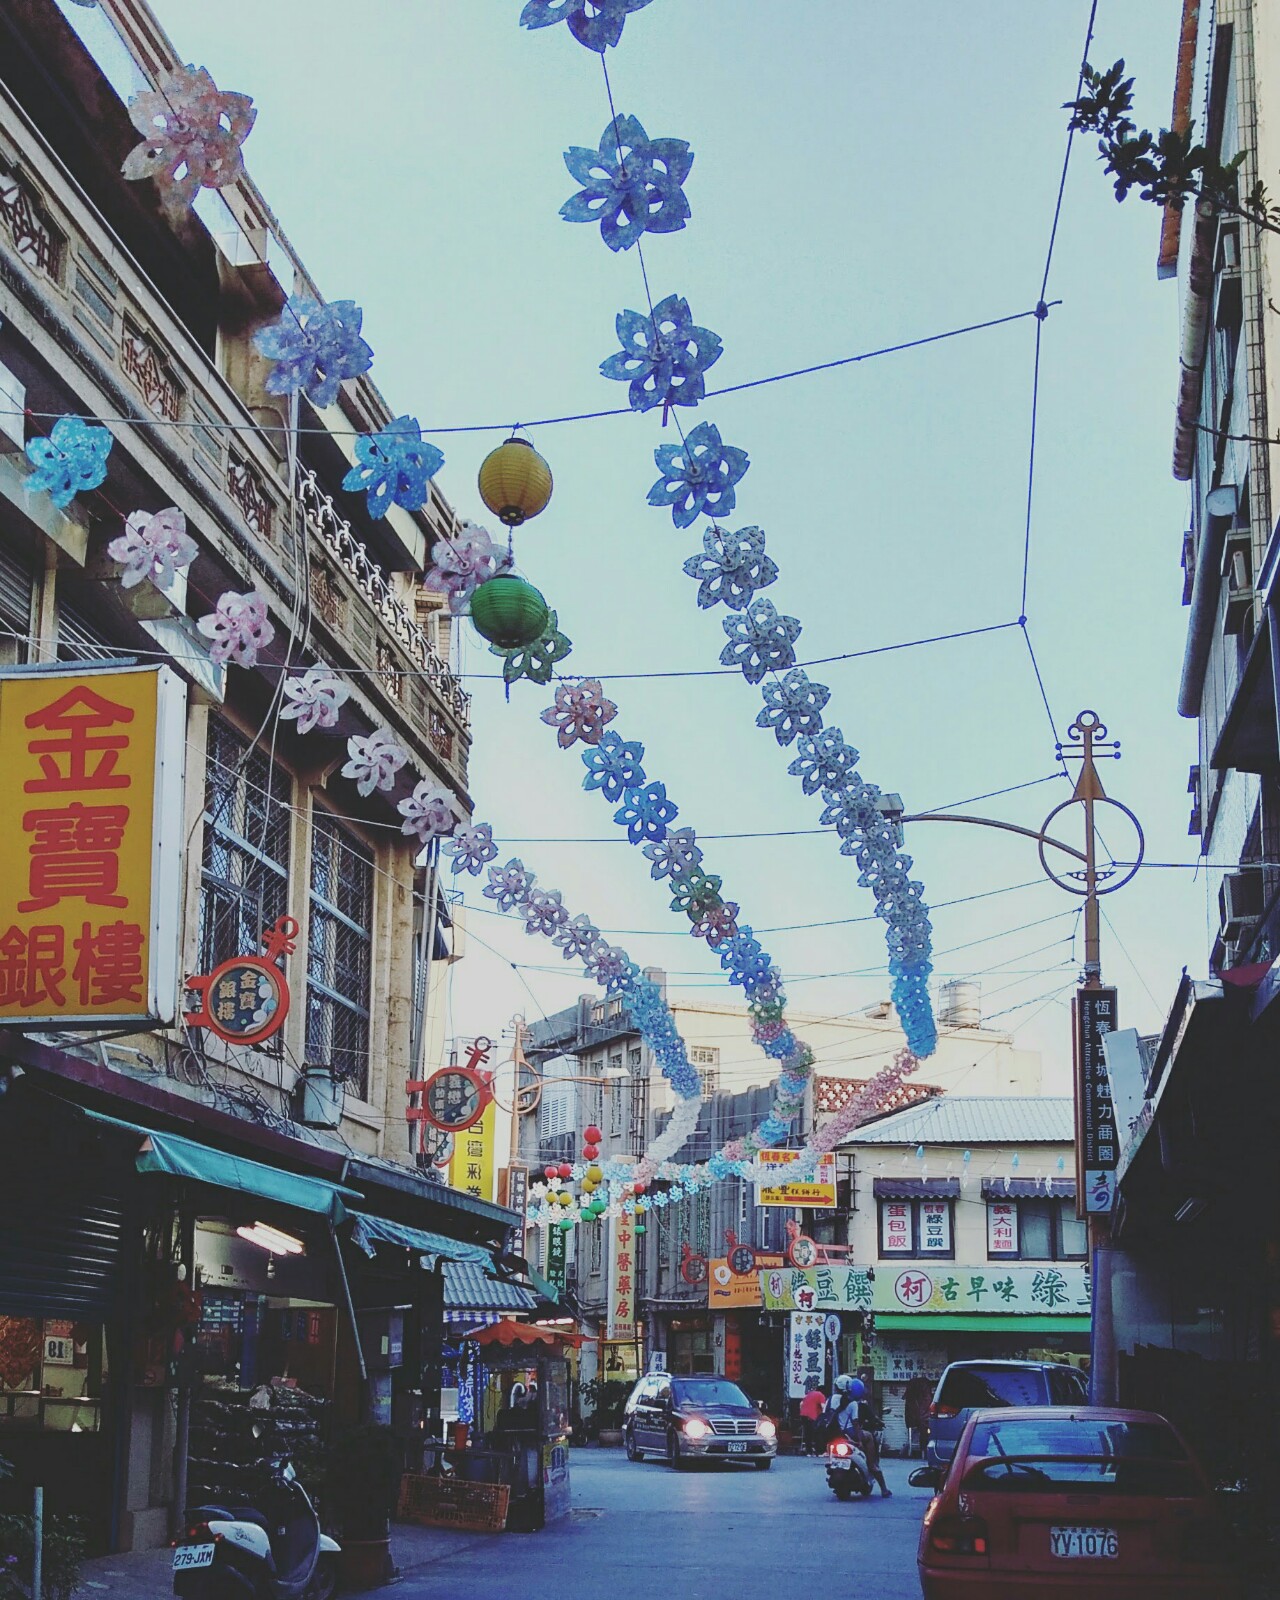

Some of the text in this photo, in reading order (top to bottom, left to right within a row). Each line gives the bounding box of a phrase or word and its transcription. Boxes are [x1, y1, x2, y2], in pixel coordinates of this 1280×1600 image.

[17, 685, 135, 913] 金寶
[0, 920, 145, 1008] 銀樓
[217, 980, 237, 1020] 銀樓
[239, 970, 258, 1010] 金寶
[1084, 1043, 1092, 1080] Attractive
[1085, 1083, 1093, 1130] Commercial
[1086, 1133, 1094, 1161] District
[887, 1204, 907, 1248] 蛋包飯
[926, 1214, 943, 1248] 綠豆饌
[799, 1290, 813, 1309] 柯
[900, 1276, 927, 1302] 柯
[941, 1276, 1019, 1302] 古早味
